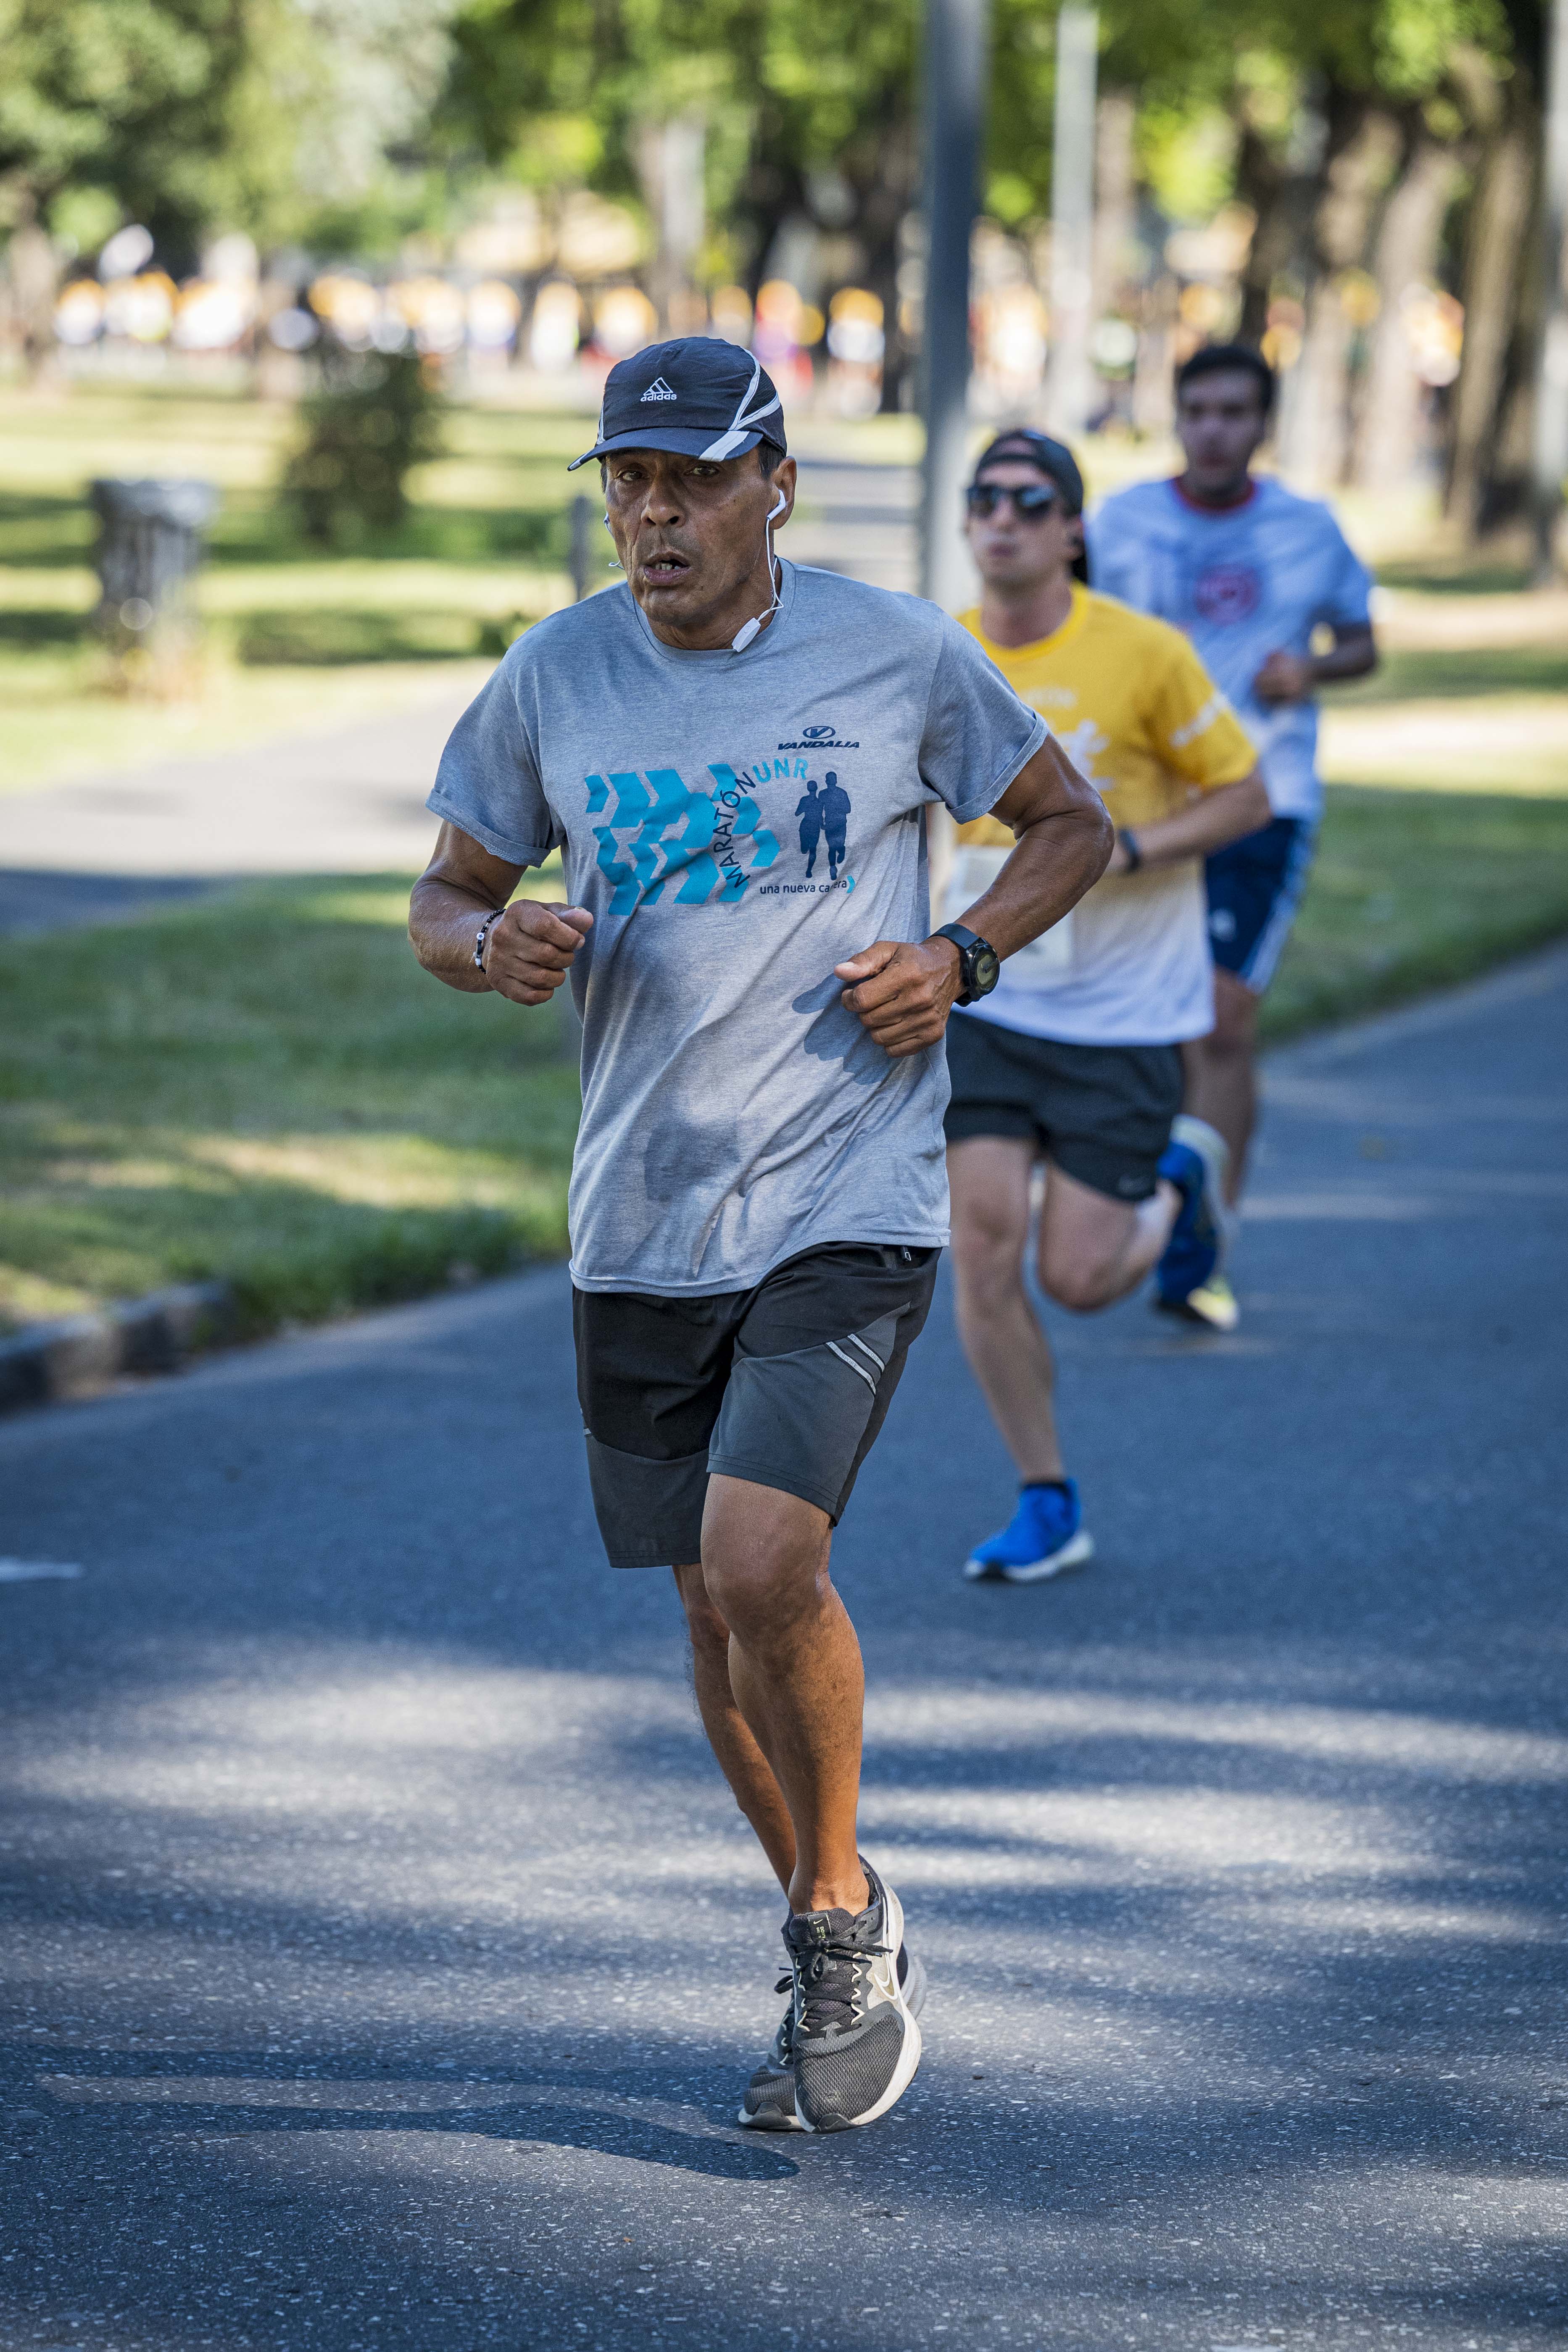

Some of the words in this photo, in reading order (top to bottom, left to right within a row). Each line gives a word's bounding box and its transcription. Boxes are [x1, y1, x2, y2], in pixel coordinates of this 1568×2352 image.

[640, 392, 677, 402] adidas
[777, 741, 860, 750] VANDALIA
[712, 772, 756, 888] MARATÓN
[752, 758, 809, 783] UNR
[760, 885, 780, 894] una
[783, 885, 816, 893] nueva
[841, 1354, 856, 1367] SPORT
